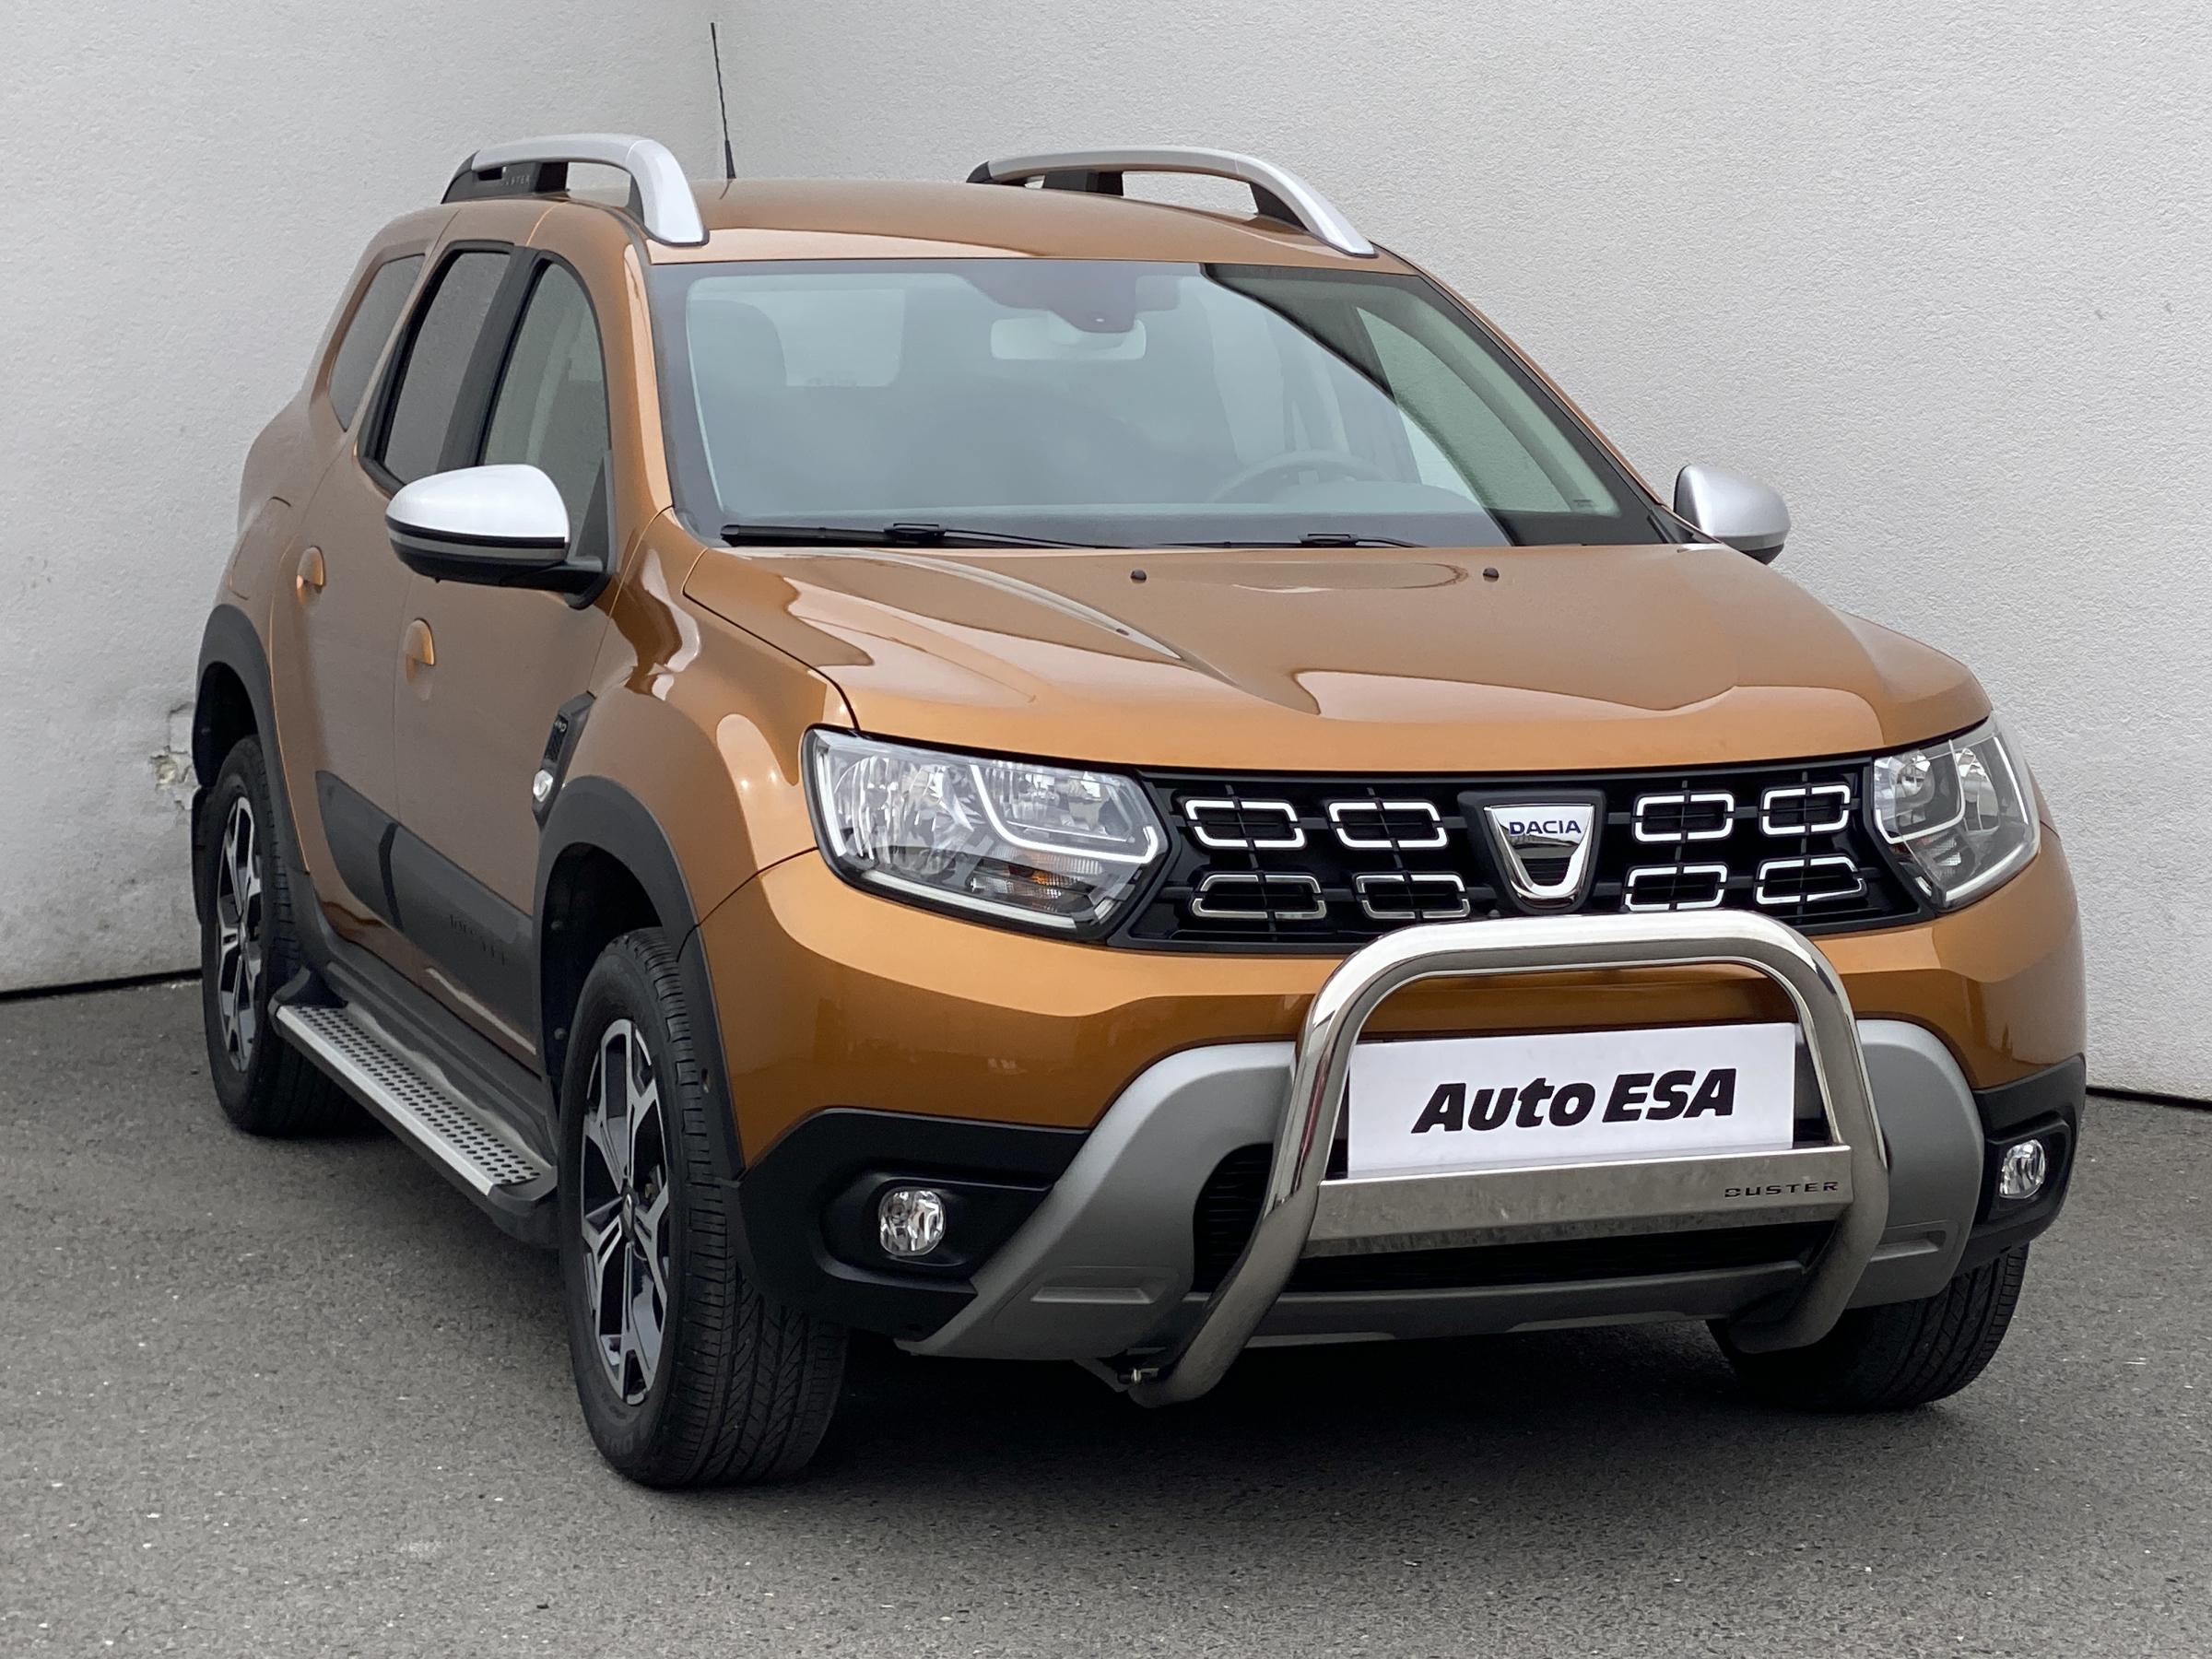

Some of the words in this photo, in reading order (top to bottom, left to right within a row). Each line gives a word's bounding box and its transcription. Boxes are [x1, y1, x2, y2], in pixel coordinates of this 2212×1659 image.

[1509, 819, 1582, 835] DACIA
[1410, 1077, 1595, 1134] Auto
[1602, 1067, 1736, 1124] ESA
[1724, 1182, 1839, 1198] DUSTER
